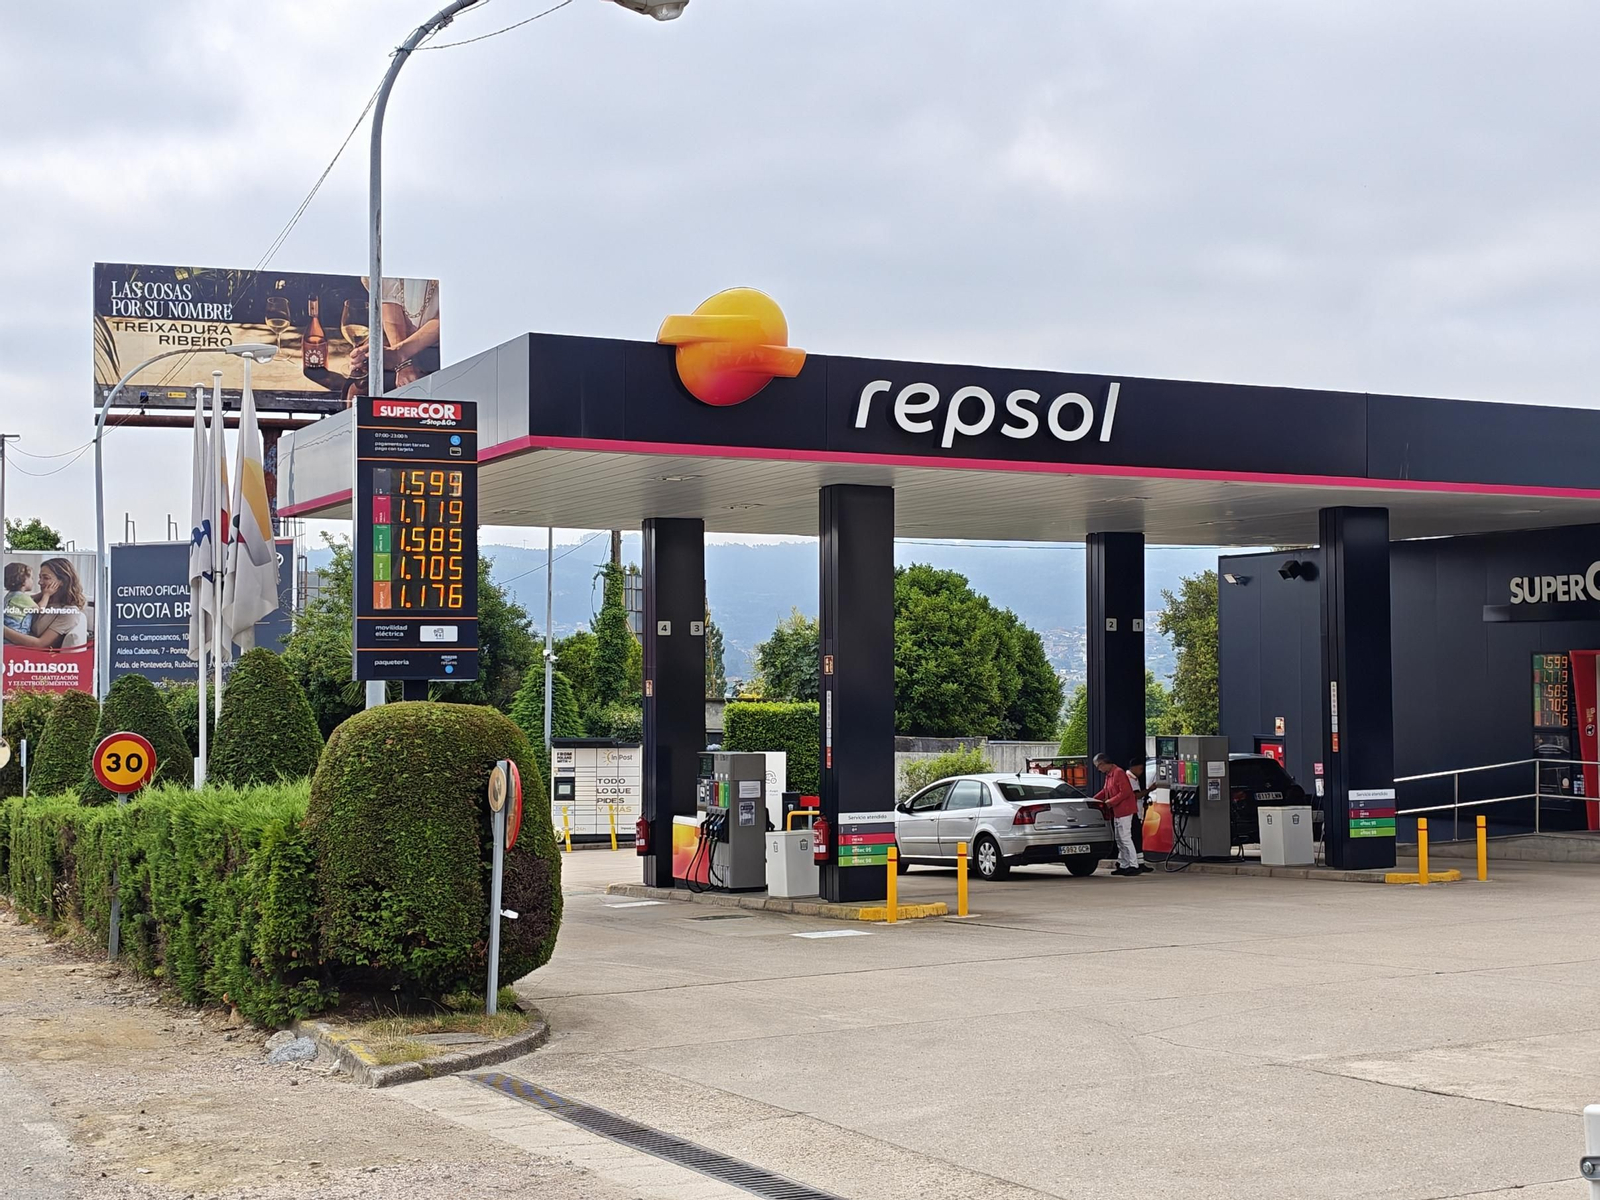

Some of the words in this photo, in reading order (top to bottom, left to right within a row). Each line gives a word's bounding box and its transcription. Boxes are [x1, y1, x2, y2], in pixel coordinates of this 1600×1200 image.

[111, 281, 141, 298] LAS
[144, 282, 191, 300] COSAS
[111, 299, 140, 316] POR
[144, 300, 164, 317] SU
[168, 302, 233, 320] NOMBRE
[113, 321, 233, 335] TREIXADURA
[159, 335, 233, 347] RIBEIRO
[380, 403, 456, 419] SUPERCOR
[854, 379, 1121, 448] repsol
[400, 471, 463, 496] 1.599
[400, 499, 463, 524] 1.719
[400, 527, 463, 552] 1.585
[400, 556, 463, 580] 1.705
[117, 585, 154, 597] CENTRO
[155, 584, 190, 596] OFICIAL
[400, 584, 463, 608] 1.176
[3, 606, 22, 614] vida,
[40, 606, 80, 614] Johnson.
[116, 602, 171, 618] TOYOTA
[174, 602, 192, 618] BR
[660, 624, 668, 632] 4
[693, 624, 700, 632] 3
[130, 633, 139, 641] de
[139, 633, 181, 643] Camposancos,
[116, 647, 133, 655] Aldea
[133, 647, 160, 656] Cabanas,
[7, 659, 80, 676] johnson
[114, 661, 130, 669] Avda.
[131, 661, 140, 669] de
[140, 661, 174, 669] Pontevedra,
[1543, 656, 1568, 669] 1.599
[106, 753, 143, 773] 30
